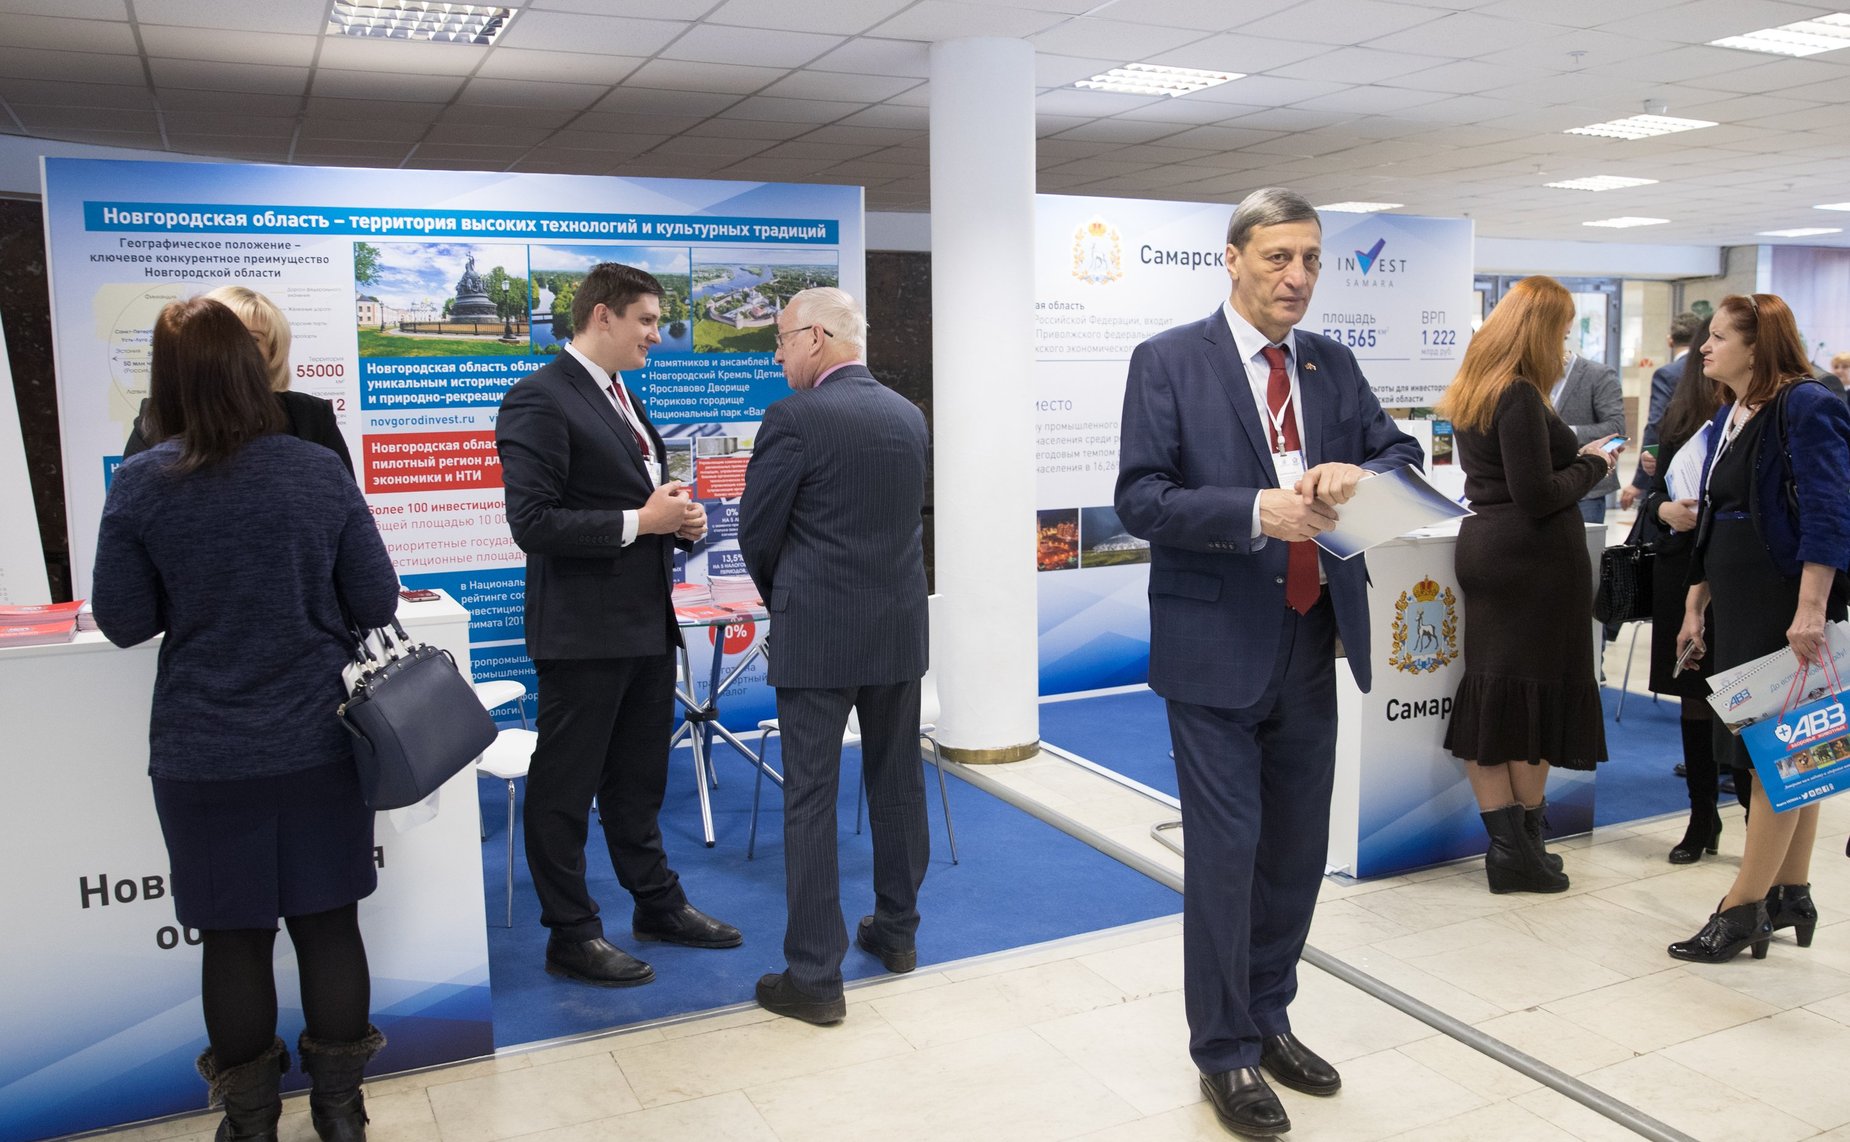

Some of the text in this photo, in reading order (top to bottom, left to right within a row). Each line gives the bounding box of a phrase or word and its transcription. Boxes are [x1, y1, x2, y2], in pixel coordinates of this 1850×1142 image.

[103, 207, 247, 229] Новгородская
[253, 210, 330, 228] область
[350, 215, 457, 233] территория
[461, 217, 537, 232] высоких
[540, 219, 638, 234] технологий
[641, 222, 652, 234] и
[656, 222, 750, 239] культурных
[753, 223, 827, 239] традиций
[119, 237, 222, 250] Географическое
[225, 241, 292, 249] положение
[90, 254, 330, 266] ключевое конкурентное преимущество
[1140, 244, 1224, 270] Самарск
[144, 267, 281, 279] Новгородской области
[1346, 278, 1395, 288] SAMARA
[1048, 300, 1085, 310] область
[1144, 317, 1173, 326] входит
[1322, 312, 1377, 326] площадь
[1421, 310, 1446, 325] ВРП
[1036, 328, 1102, 340] Приволжского
[1347, 328, 1377, 347] 565
[1422, 329, 1456, 345] 1 222
[367, 362, 456, 375] Новгородская
[459, 360, 507, 372] область
[654, 359, 710, 368] памятников
[712, 359, 718, 367] и
[720, 357, 770, 367] ансамблей
[296, 364, 345, 378] 55000
[649, 370, 716, 382] Новгородский
[718, 370, 753, 381] Кремль
[367, 378, 448, 391] уникальным
[649, 383, 750, 395] Ярославово Дворище
[1396, 384, 1409, 393] для
[368, 391, 506, 406] и природно-рекреаци
[649, 396, 745, 407] Рюриково городище
[1396, 394, 1424, 403] области
[370, 413, 475, 428] novgorodinvest.ru
[649, 408, 719, 420] Национальный
[720, 409, 742, 418] парк
[1044, 421, 1119, 432] промышленного
[371, 440, 460, 455] Новгородская
[1085, 436, 1111, 446] среди
[1082, 448, 1115, 458] темпом
[372, 455, 503, 470] пилотный регион дл
[373, 469, 482, 486] экономики и НТИ
[367, 503, 404, 515] Более
[407, 502, 428, 514] 100
[725, 508, 739, 517] 0%
[375, 519, 408, 531] бщей
[411, 517, 475, 531] площадью
[479, 514, 492, 525] 10
[387, 538, 467, 553] риоритетные
[392, 554, 473, 568] естиционные
[460, 579, 526, 591] в Националь
[461, 593, 508, 606] рейтинге
[723, 687, 748, 697] алог
[1386, 696, 1452, 722] Самар
